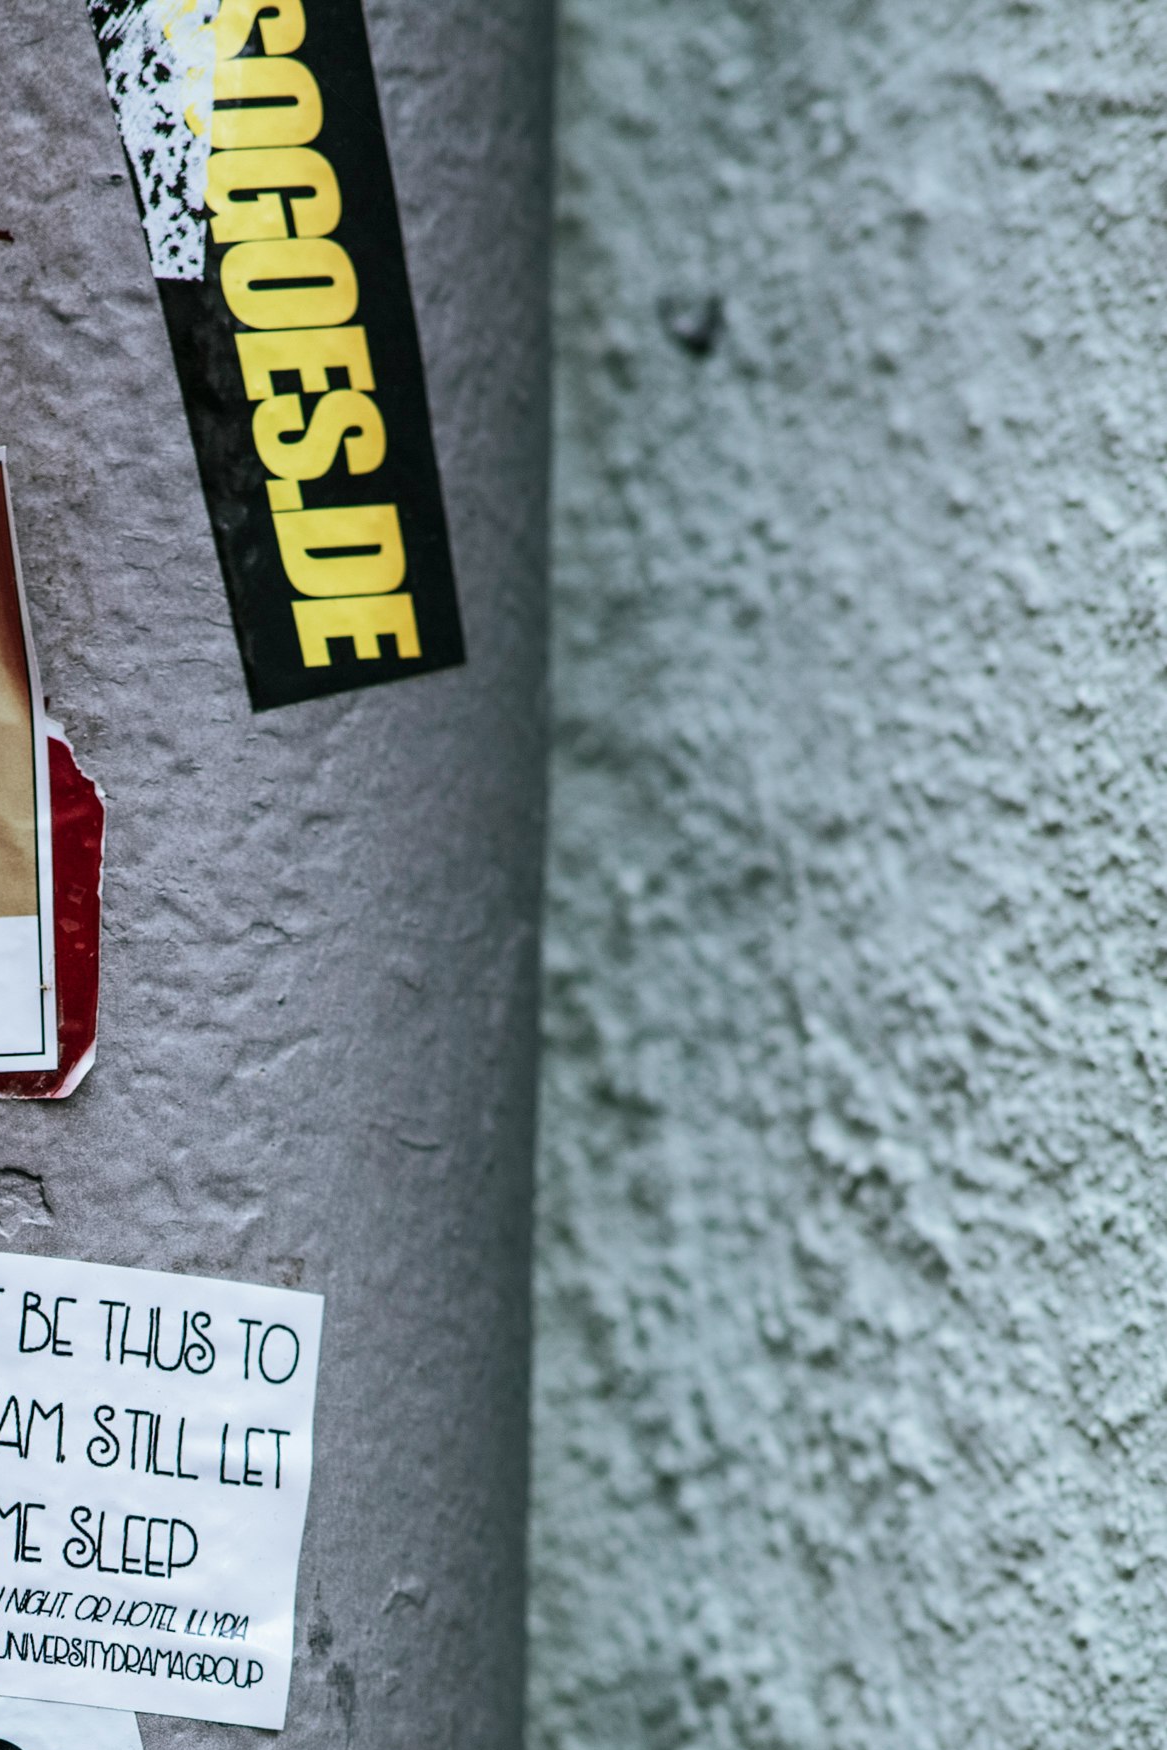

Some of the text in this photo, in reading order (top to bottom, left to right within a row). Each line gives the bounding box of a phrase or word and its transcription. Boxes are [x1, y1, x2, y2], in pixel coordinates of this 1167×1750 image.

[19, 1291, 77, 1357] BE
[99, 1299, 217, 1375] THUS
[239, 1318, 300, 1384] TO
[86, 1404, 199, 1481] STILL
[220, 1423, 291, 1489] LET
[62, 1505, 199, 1580] SLEEP
[74, 1594, 112, 1623] OR
[112, 1600, 178, 1634] HOTEL
[183, 1608, 250, 1642] ILLYRIA
